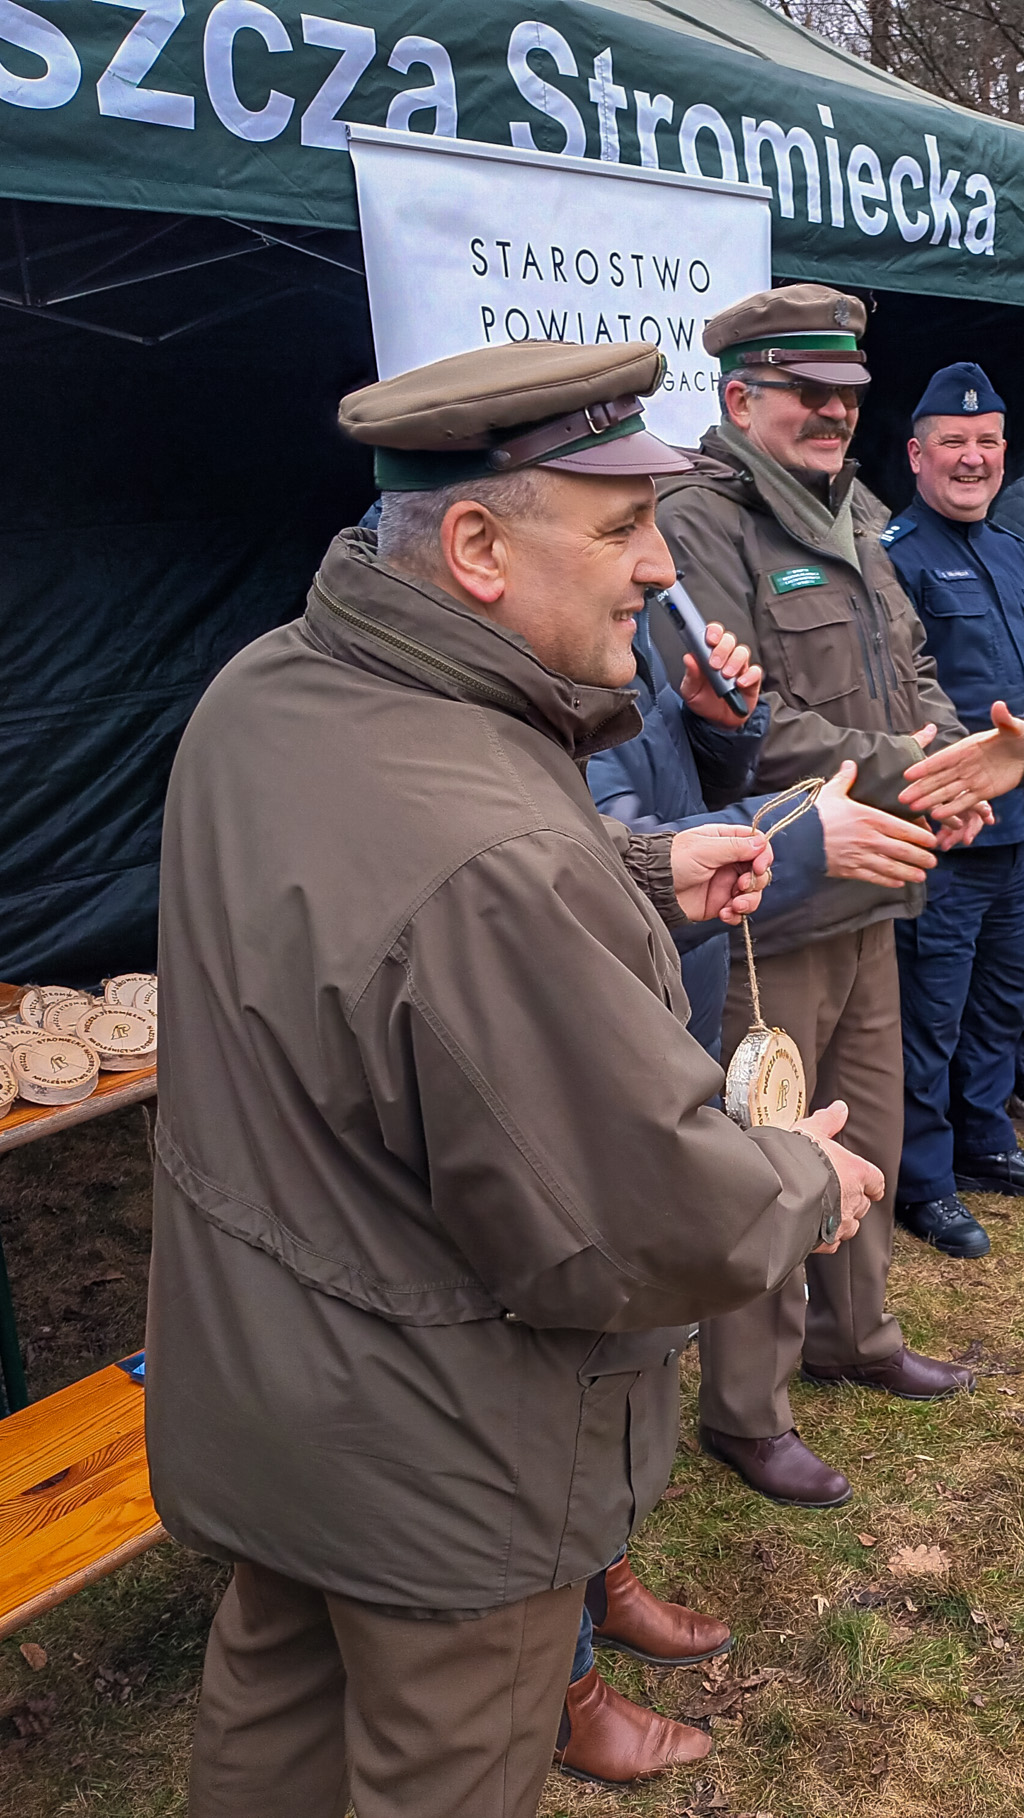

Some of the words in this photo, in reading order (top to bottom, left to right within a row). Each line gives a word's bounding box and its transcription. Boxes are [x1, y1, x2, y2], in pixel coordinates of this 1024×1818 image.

[507, 20, 998, 256] Stromiecka
[470, 238, 710, 293] STAROSTWO
[481, 305, 712, 351] POWIATOW
